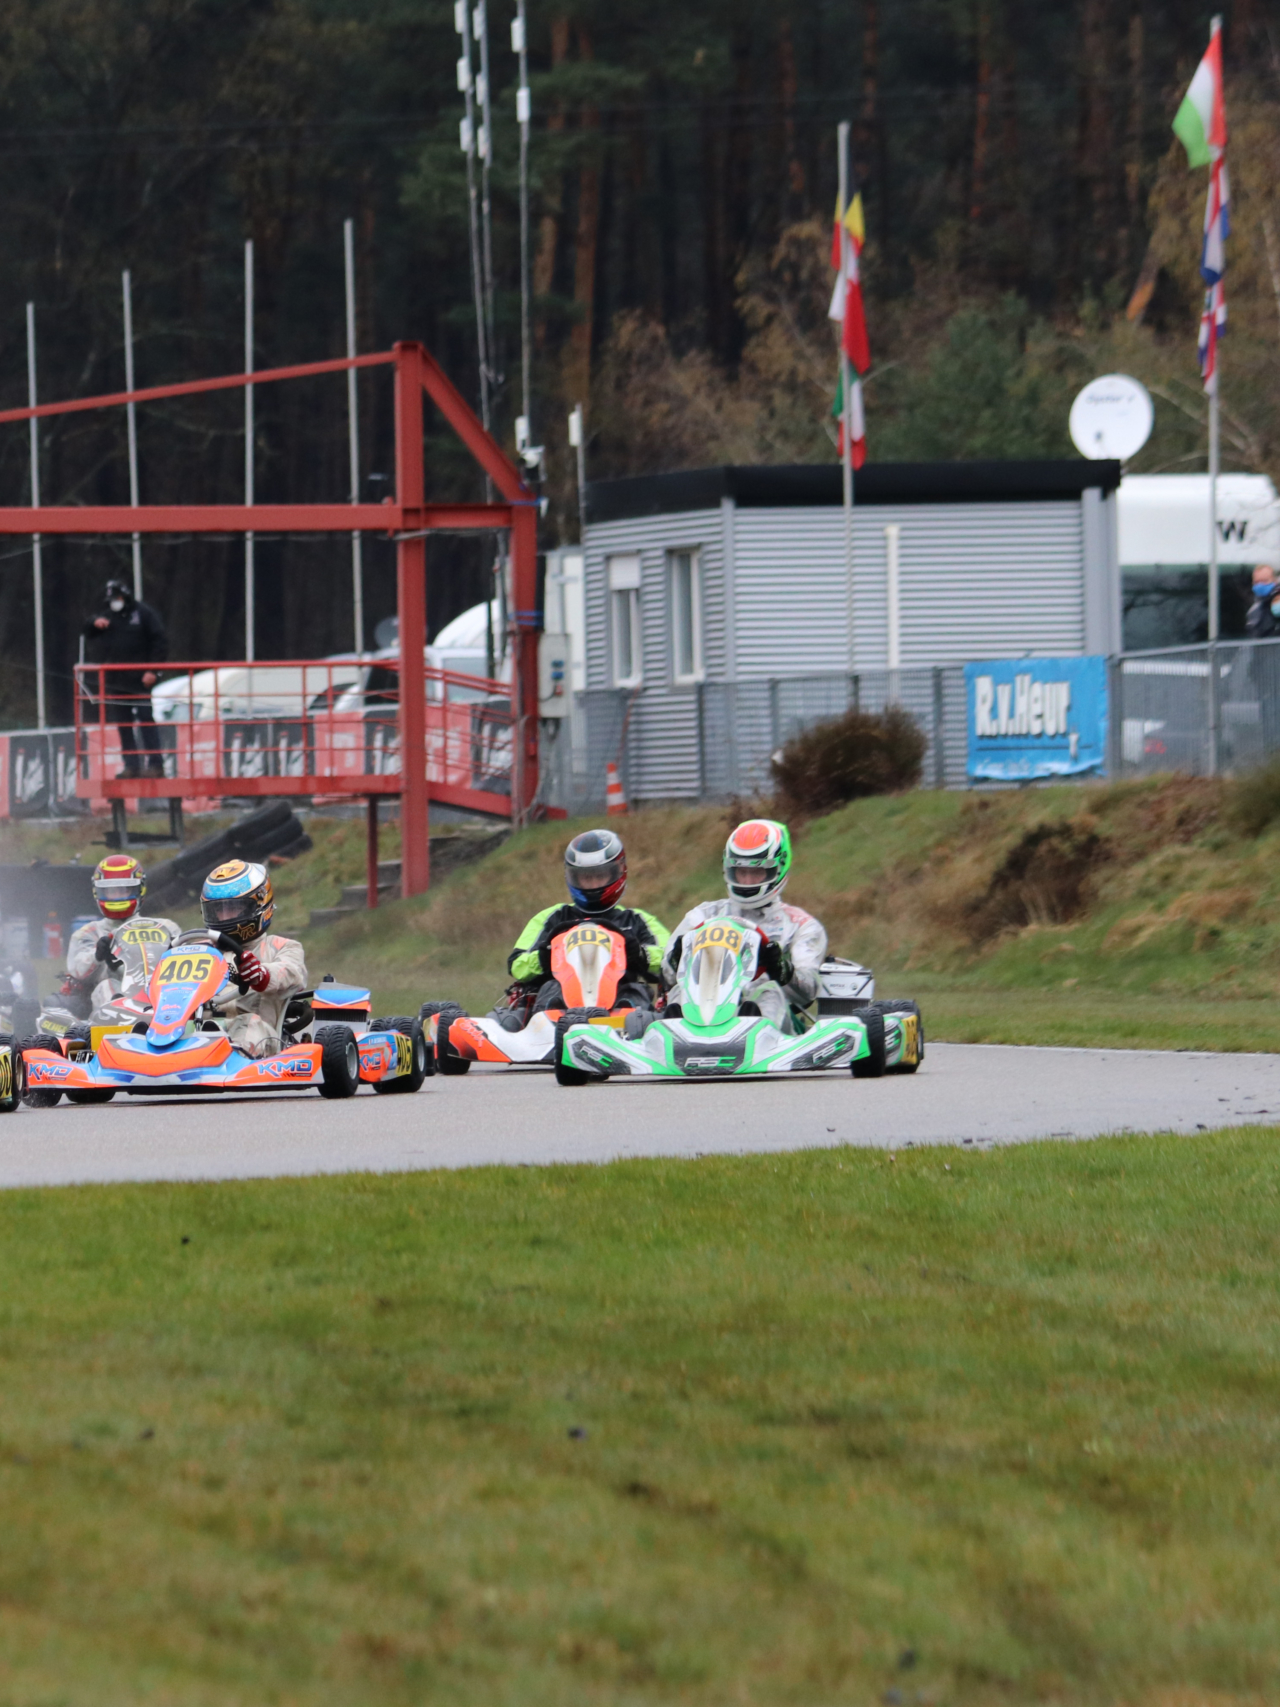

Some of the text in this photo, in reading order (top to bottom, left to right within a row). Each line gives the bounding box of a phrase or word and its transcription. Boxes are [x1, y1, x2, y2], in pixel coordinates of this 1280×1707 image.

[127, 930, 162, 943] 490
[696, 926, 740, 949] 408
[160, 959, 211, 982] 405
[28, 1063, 74, 1081] KMD
[257, 1059, 313, 1077] KMD
